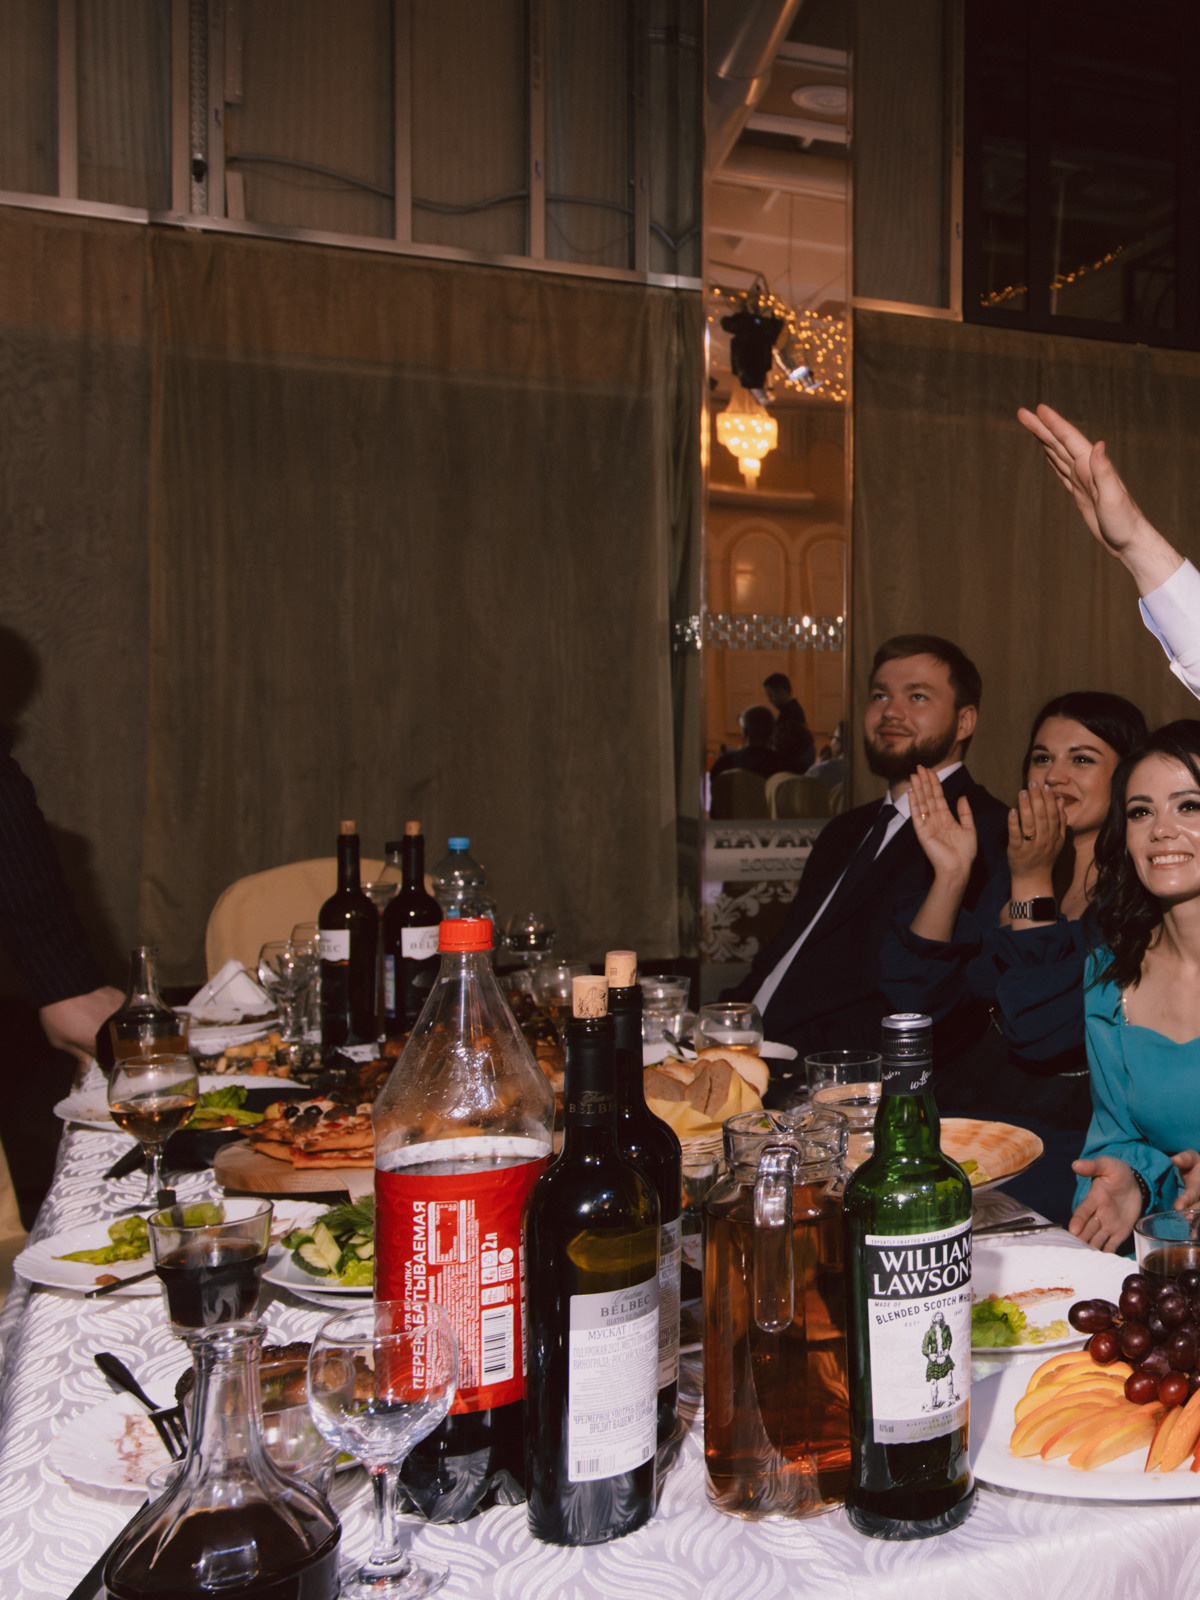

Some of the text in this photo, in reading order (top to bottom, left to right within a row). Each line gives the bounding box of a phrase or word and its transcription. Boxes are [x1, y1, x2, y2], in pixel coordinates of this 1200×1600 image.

[879, 1233, 972, 1273] WILLIAM
[873, 1257, 971, 1296] LAWSON
[412, 1201, 427, 1391] ПЕРЕРАБАТЫВАЕМАЯ
[600, 1294, 651, 1317] BELBEC
[875, 1305, 920, 1325] BLENDED
[923, 1296, 957, 1312] SCOTCH
[588, 1324, 627, 1341] МУСКАТ
